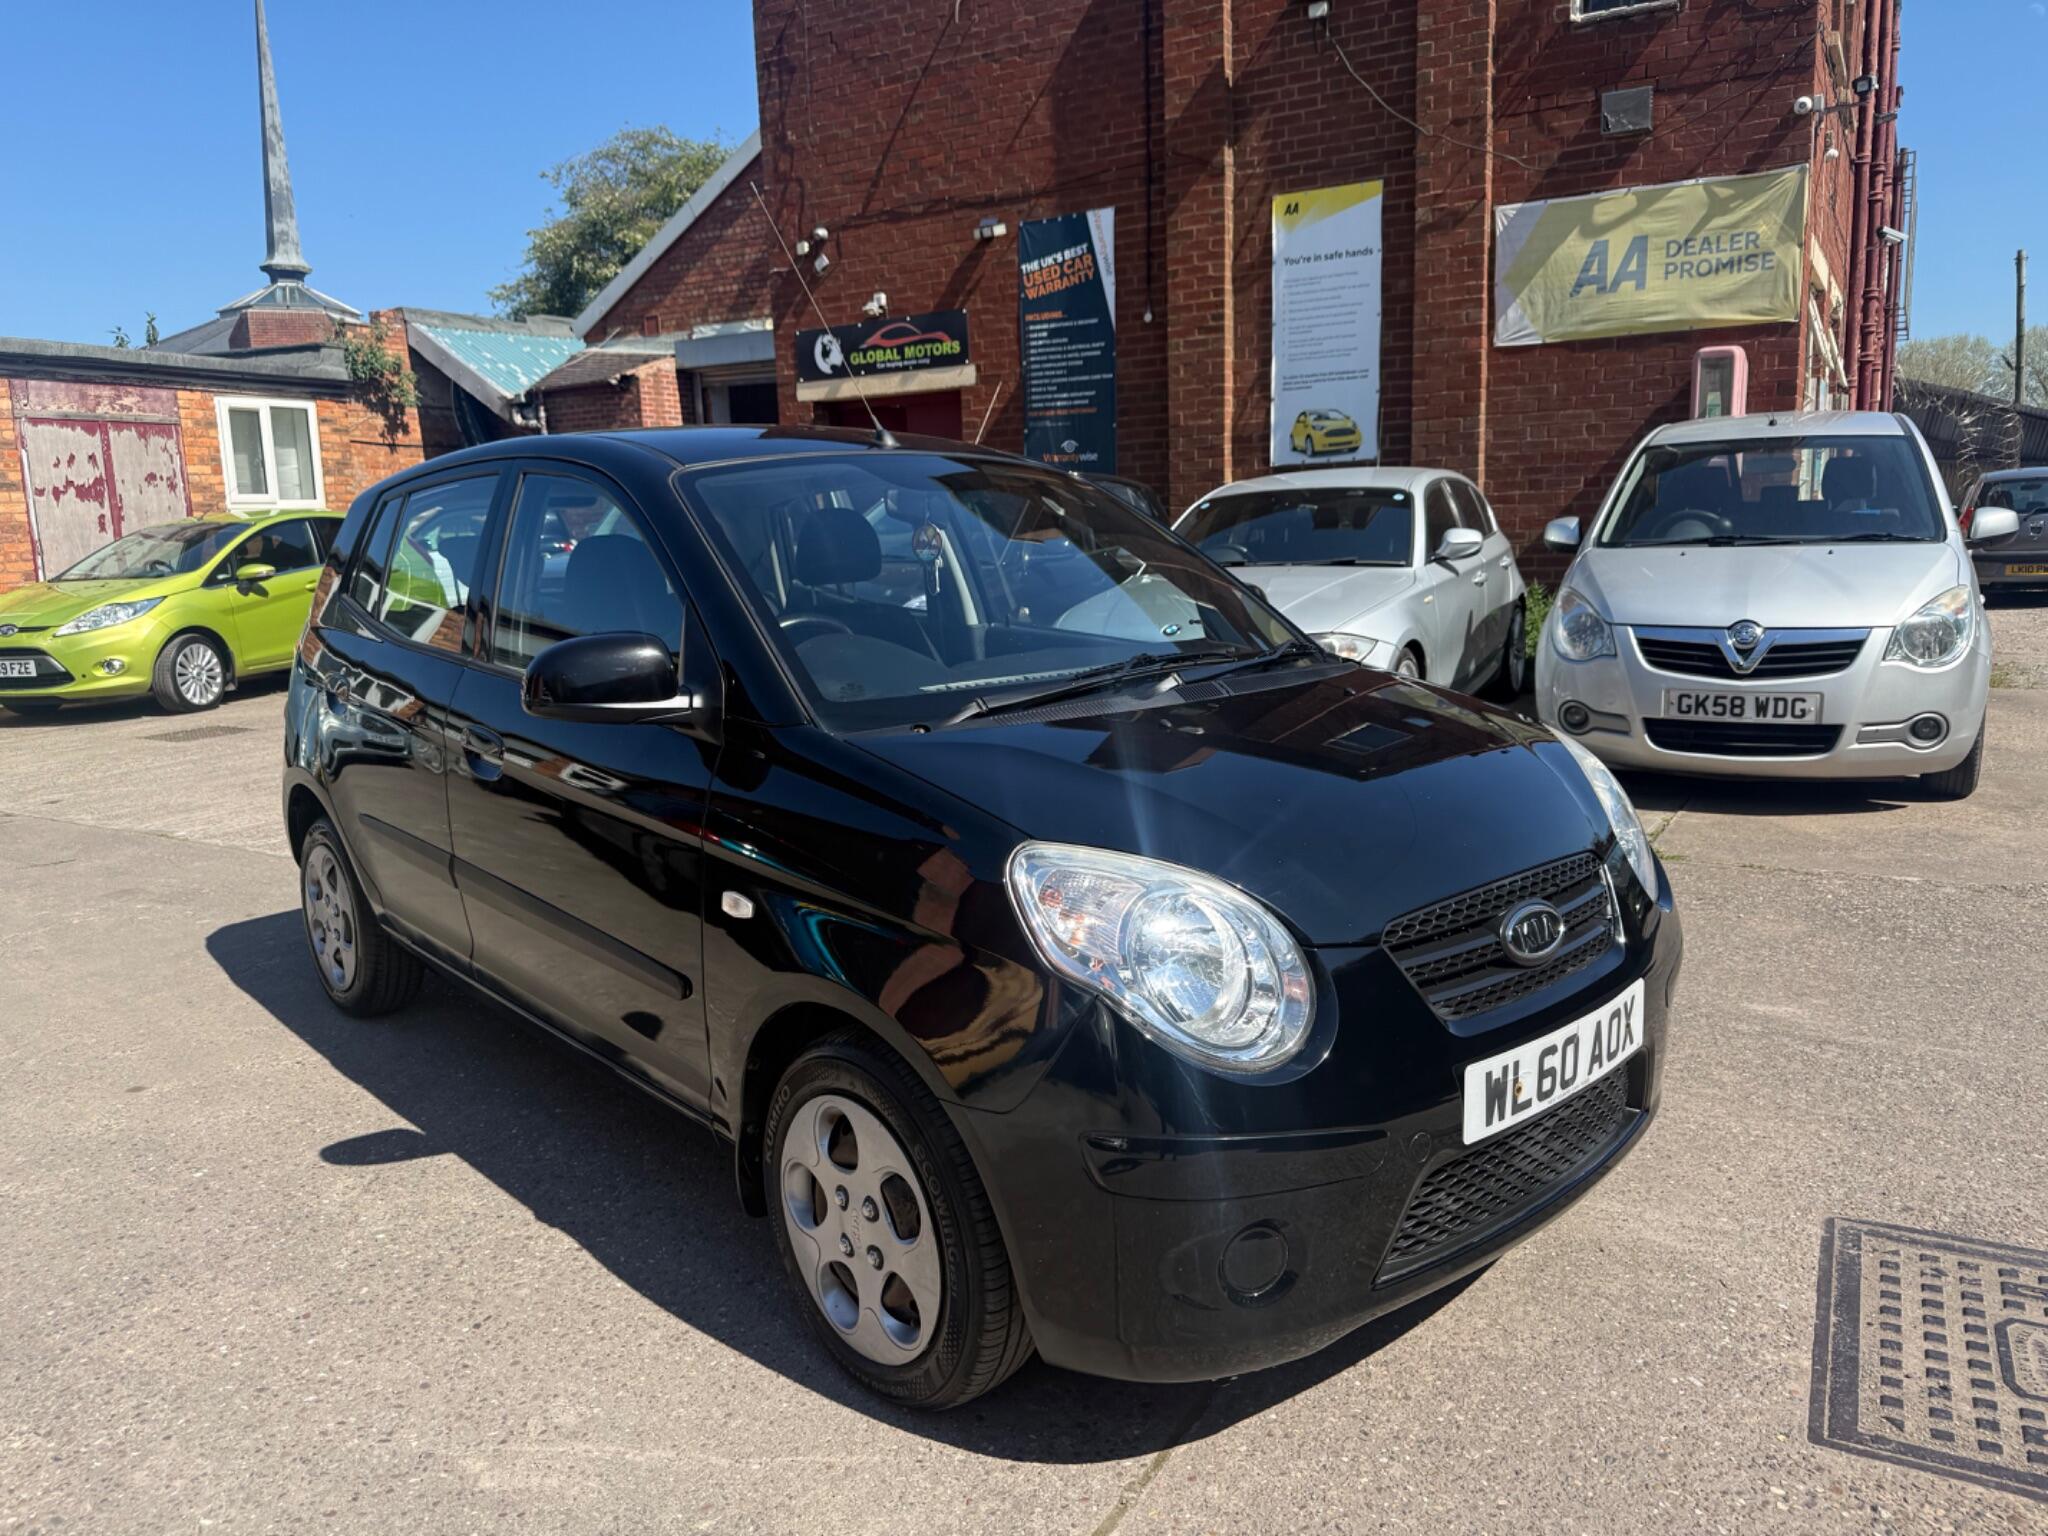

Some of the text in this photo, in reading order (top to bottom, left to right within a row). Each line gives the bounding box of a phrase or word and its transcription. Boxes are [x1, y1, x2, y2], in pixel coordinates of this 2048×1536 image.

[1284, 202, 1299, 216] AA
[1021, 243, 1088, 274] THE UK'S BEST
[1283, 246, 1374, 267] You're in safe hands
[1666, 230, 1761, 259] DEALER
[1023, 254, 1094, 288] USED CAR
[1569, 234, 1649, 298] AA
[1664, 250, 1777, 281] PROMISE
[1024, 267, 1095, 300] WARRANTY
[850, 340, 961, 366] GLOBAL MOTORS
[9, 662, 32, 675] FZE
[1677, 693, 1808, 720] GK58 WDG
[1517, 914, 1557, 952] KIA
[1485, 994, 1636, 1129] WL60 AOX
[766, 1085, 790, 1165] KUMHO
